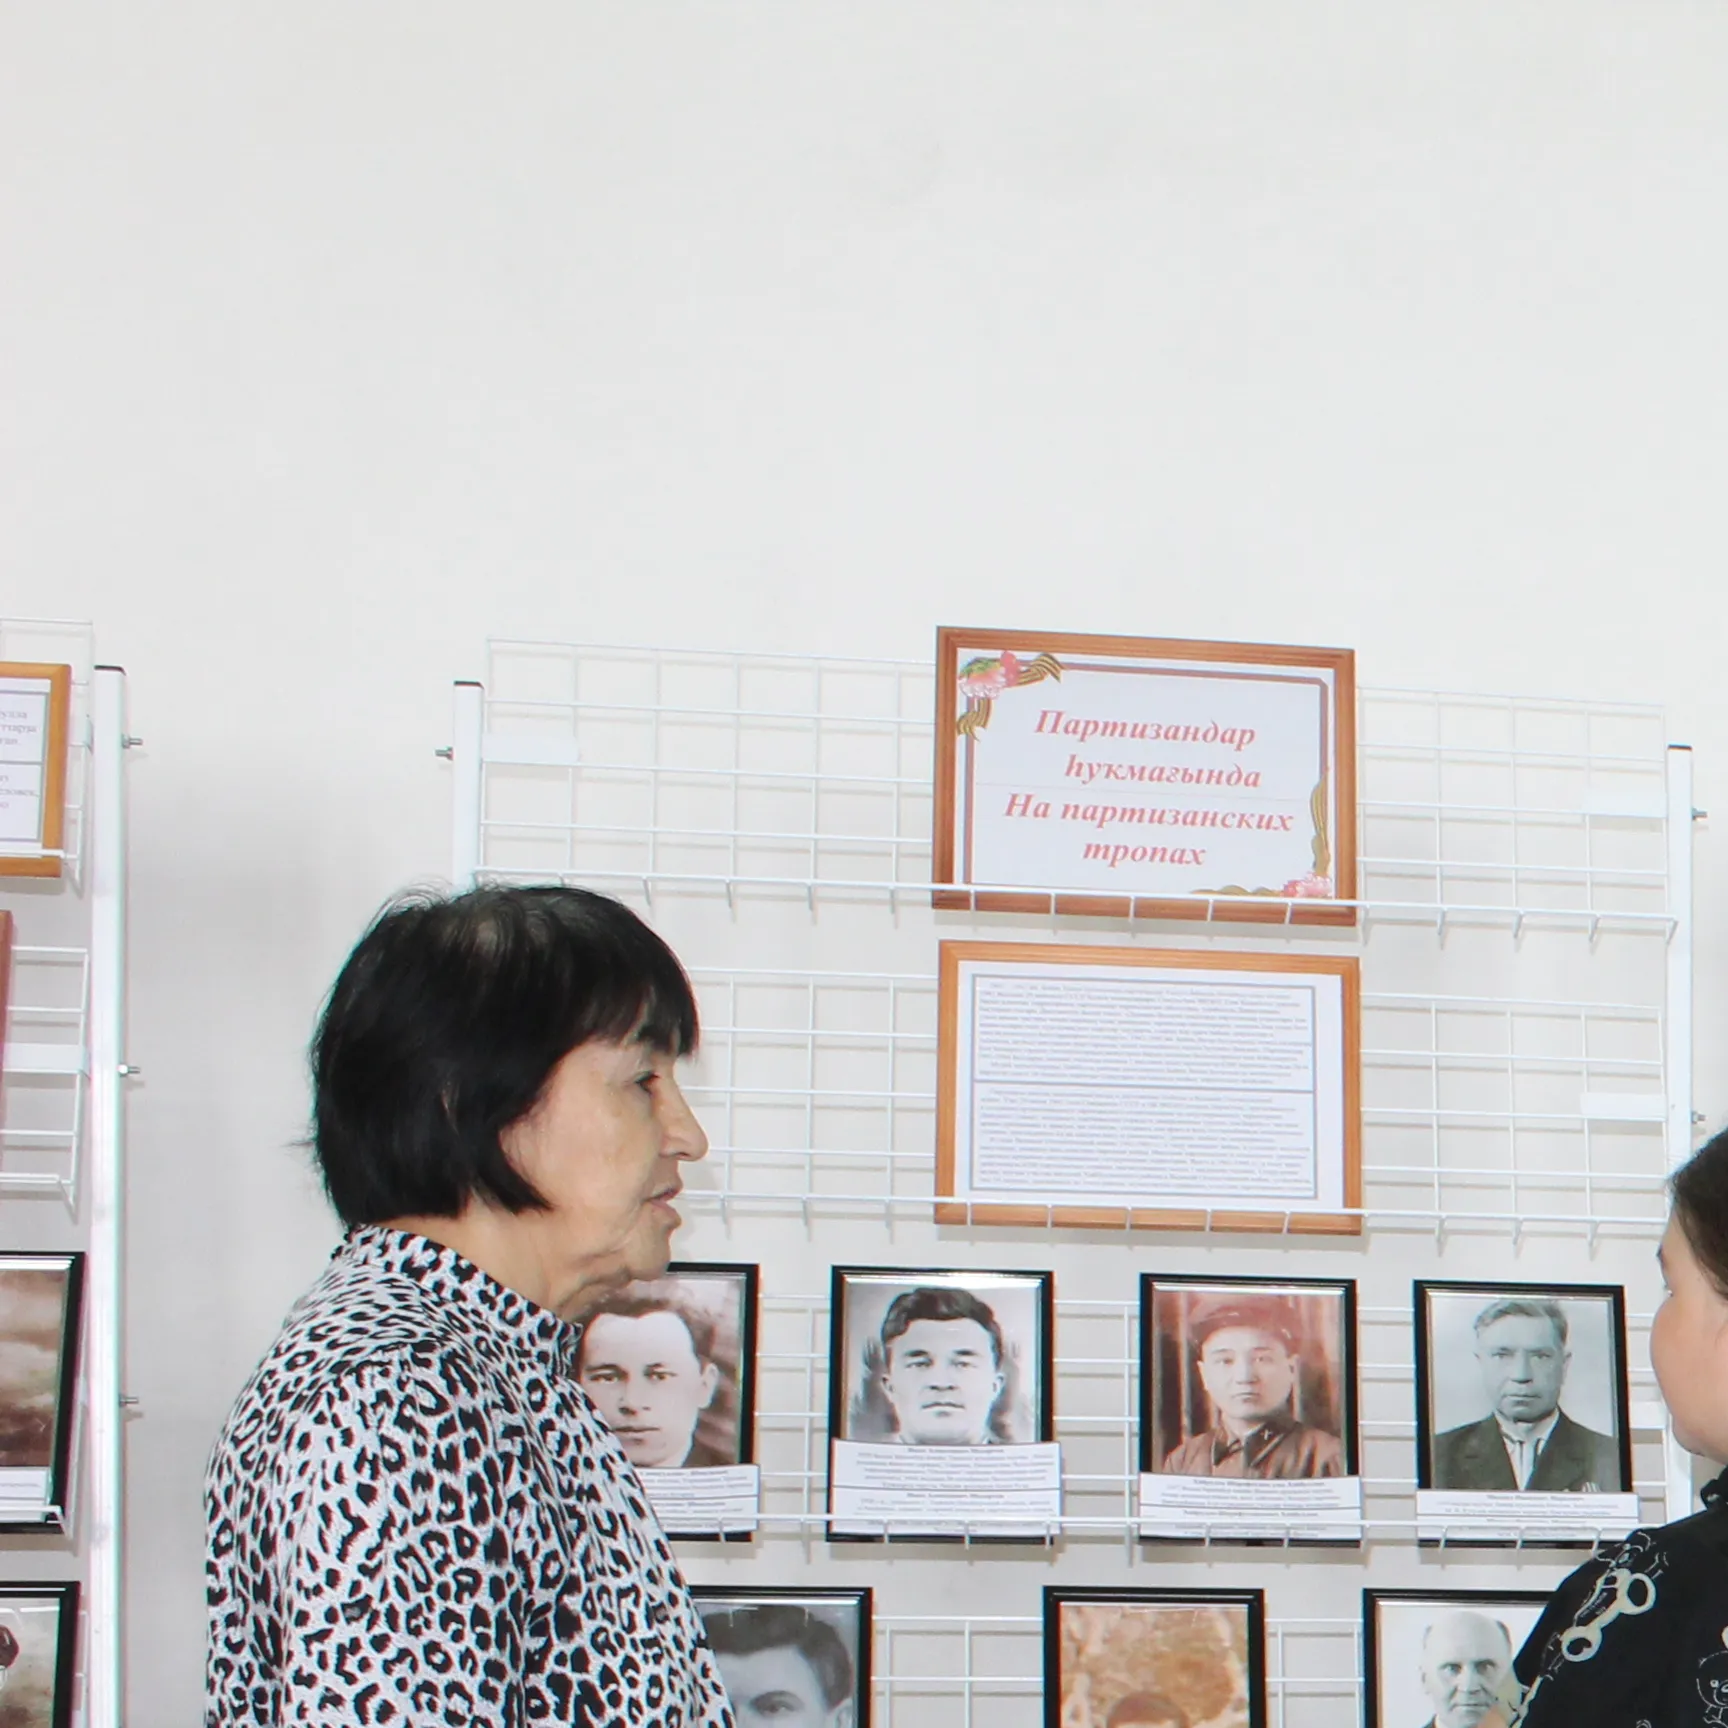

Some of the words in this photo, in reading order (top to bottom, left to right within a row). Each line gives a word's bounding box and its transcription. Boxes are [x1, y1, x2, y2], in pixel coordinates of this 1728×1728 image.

[1034, 709, 1256, 751] Партизандар
[1004, 792, 1052, 821] На
[1059, 802, 1294, 833] партизанских
[1082, 841, 1206, 868] тропах
